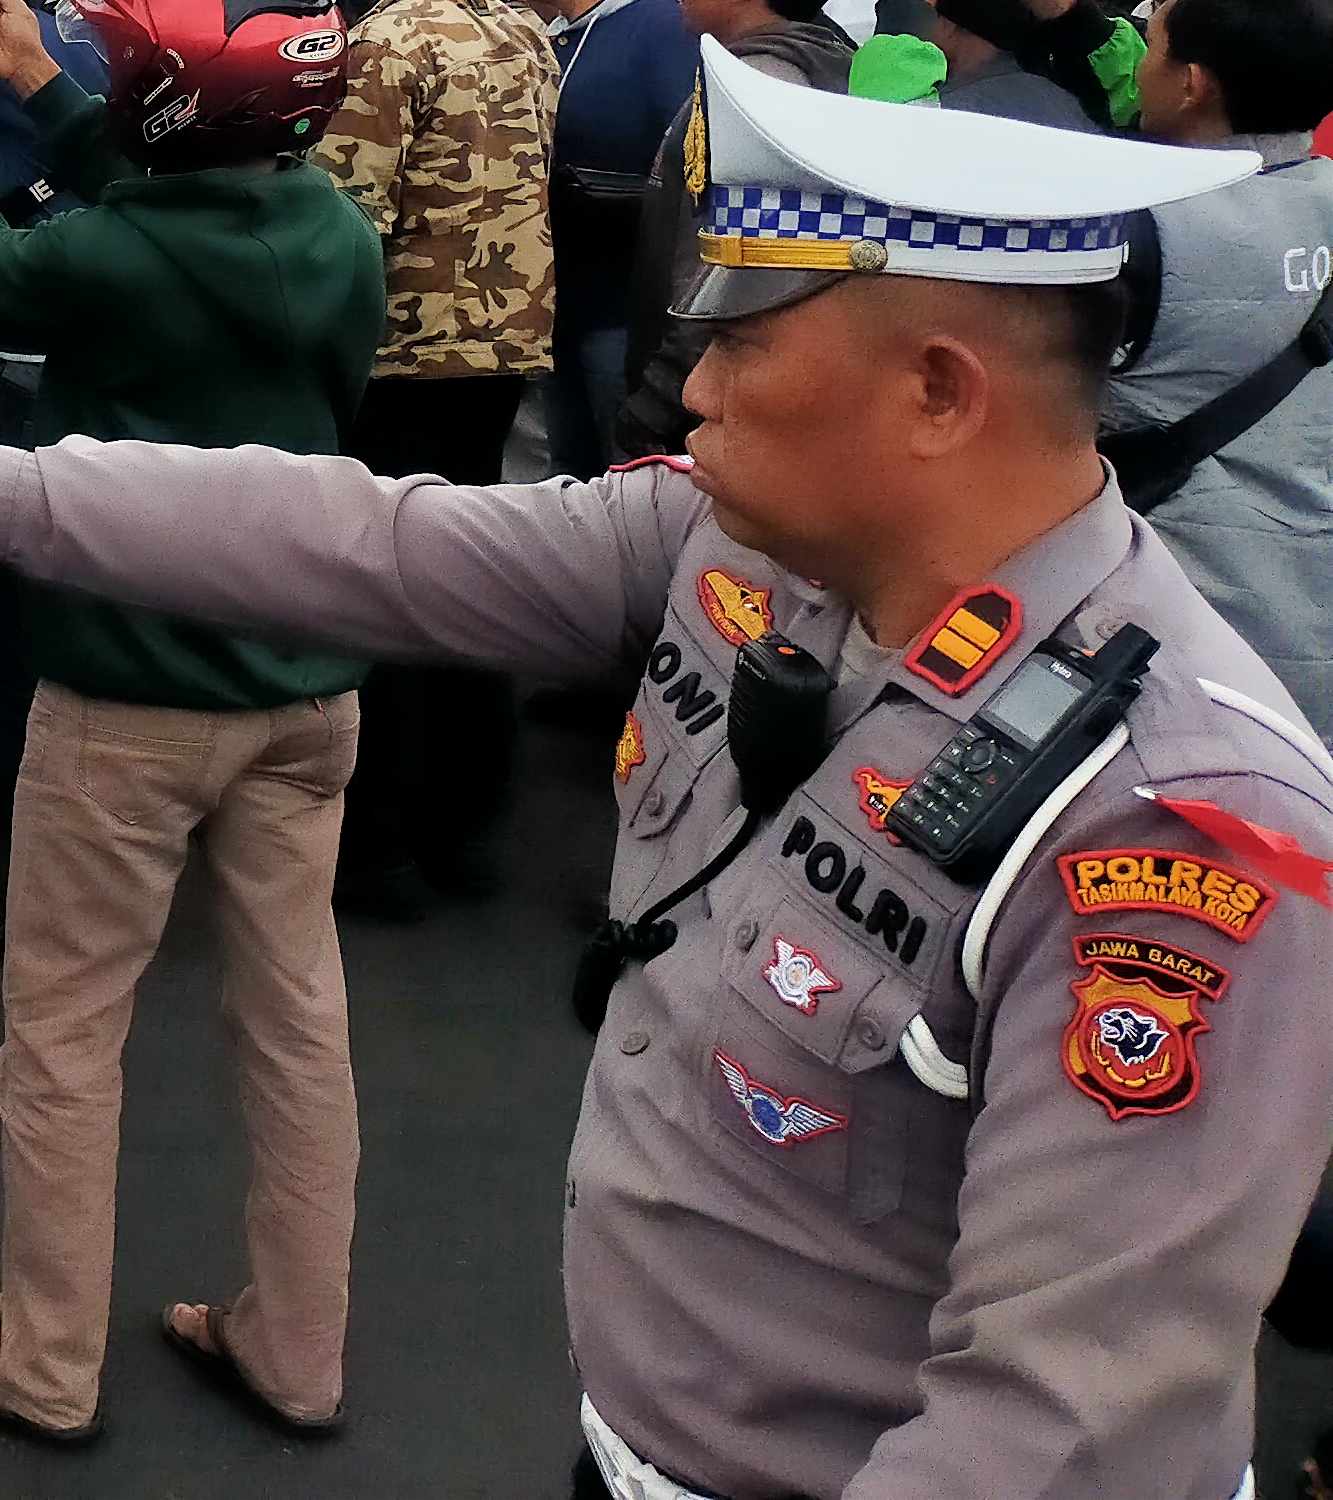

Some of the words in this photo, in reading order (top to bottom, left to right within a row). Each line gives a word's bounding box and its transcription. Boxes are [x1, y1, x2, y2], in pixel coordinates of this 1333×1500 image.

[297, 35, 339, 55] G2
[781, 815, 927, 965] POLRI
[1077, 856, 1261, 912] POLRES
[1077, 881, 1203, 908] TASIKMALAYA
[1202, 896, 1248, 931] KOTA
[1086, 941, 1140, 959] JAWA
[1148, 948, 1216, 984] BARAT
